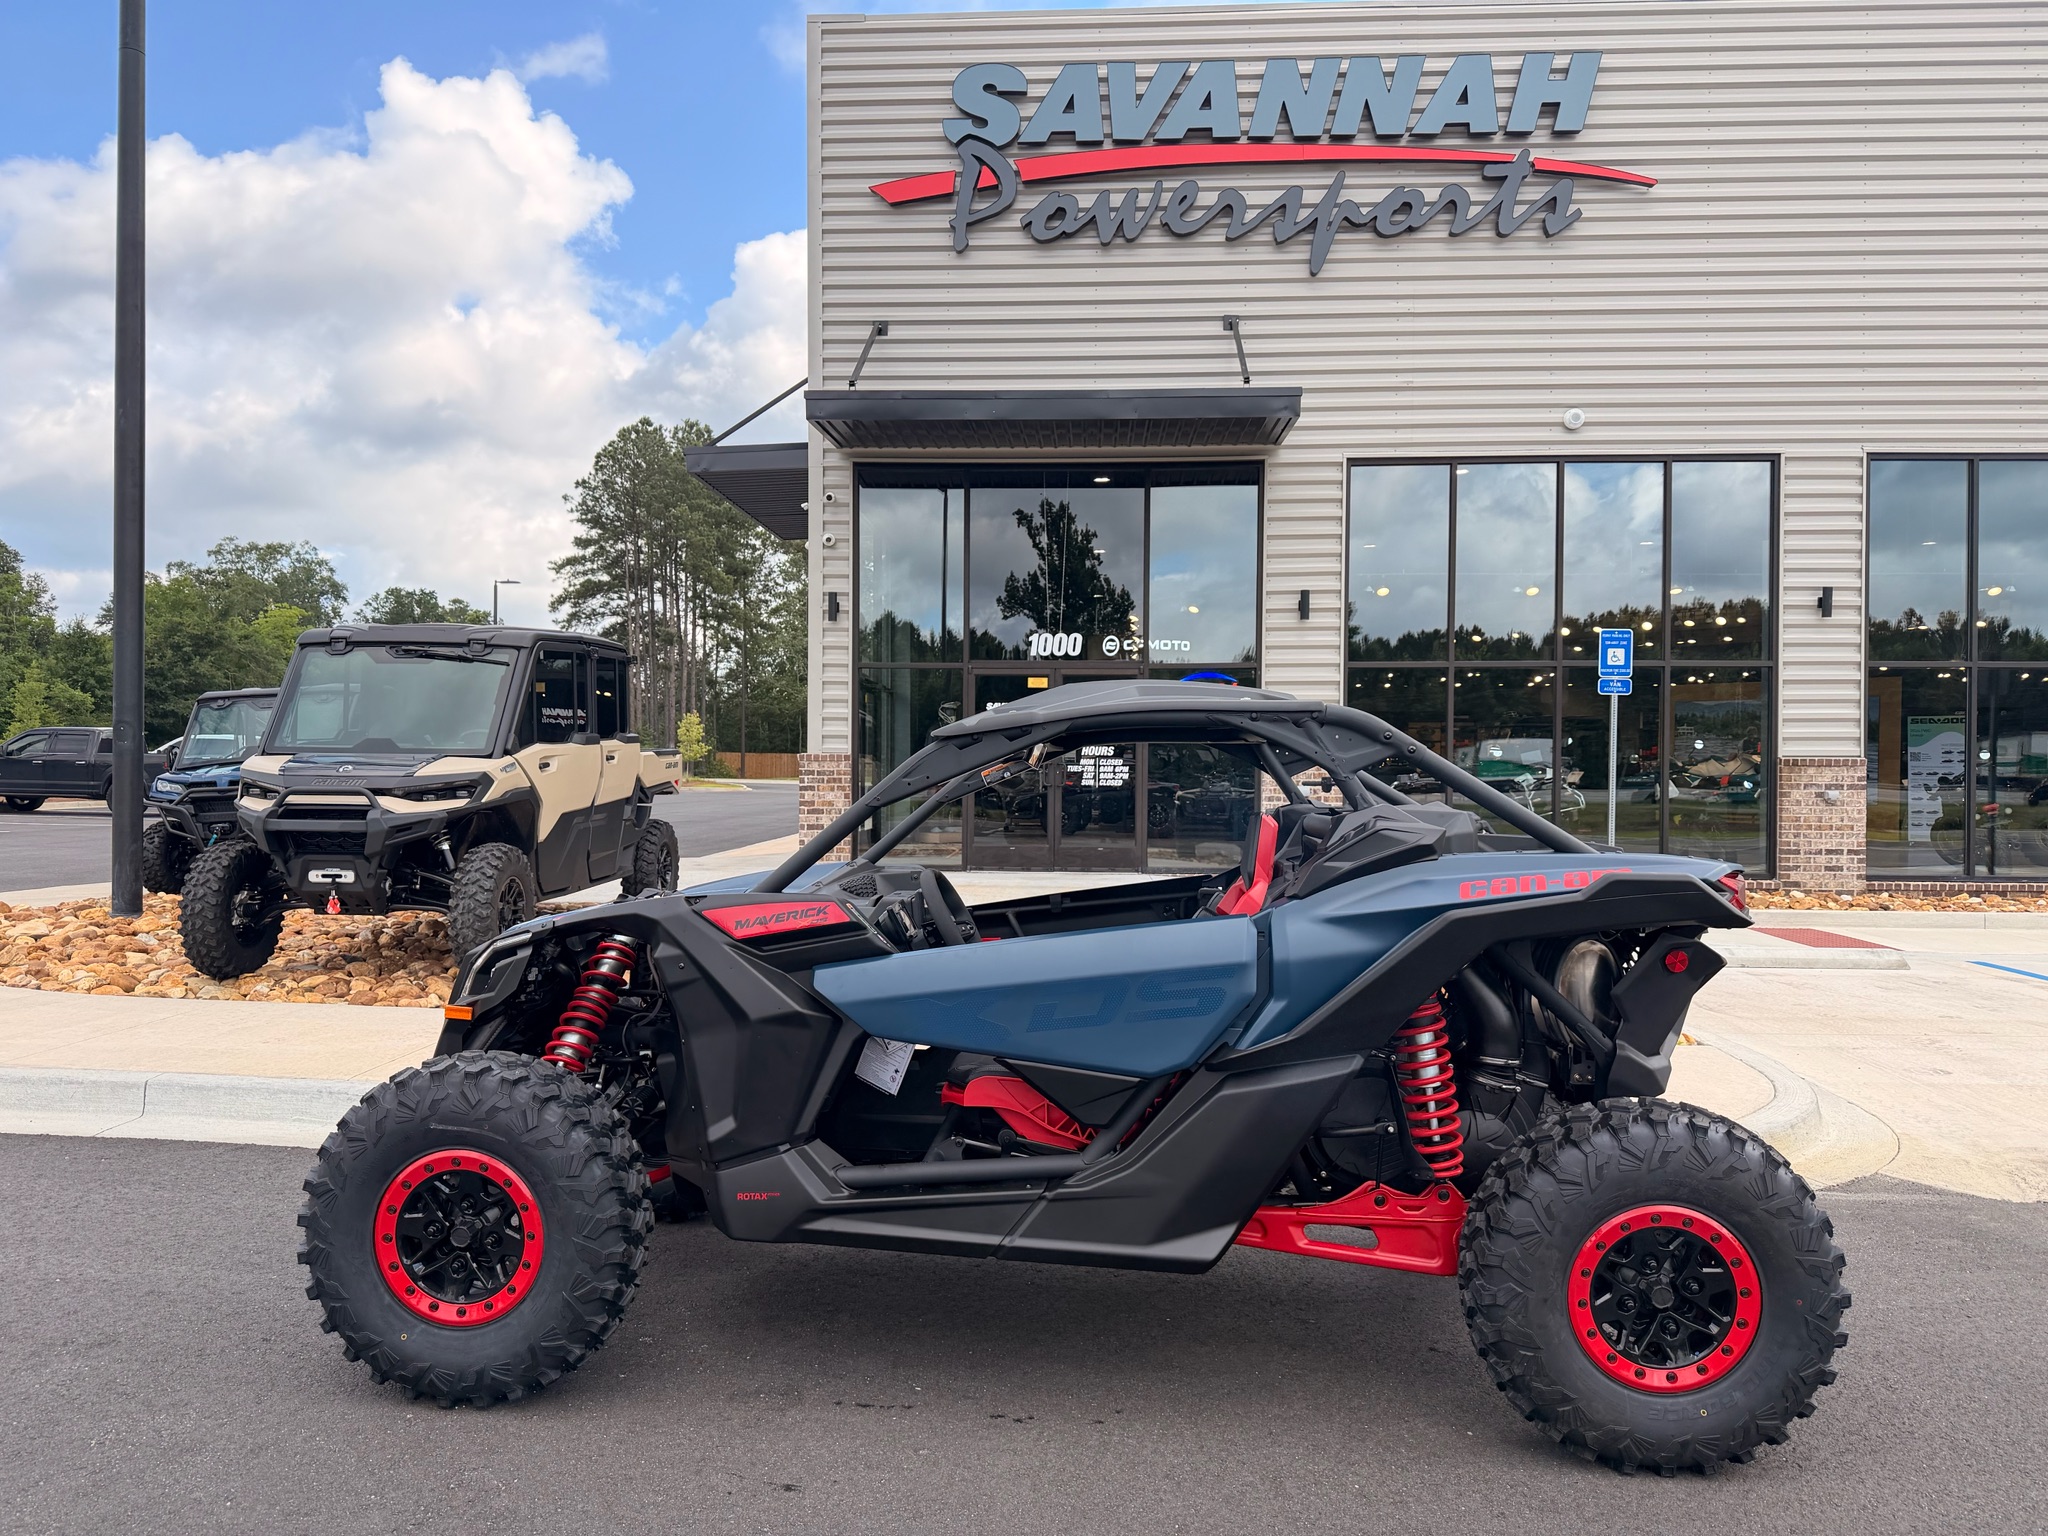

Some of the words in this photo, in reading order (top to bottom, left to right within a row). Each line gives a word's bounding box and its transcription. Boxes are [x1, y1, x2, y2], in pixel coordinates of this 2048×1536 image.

[942, 51, 1603, 146] SAVANNAH
[953, 139, 1582, 276] Powersports
[1029, 632, 1083, 657] 1000
[1081, 746, 1115, 756] HOURS
[734, 904, 831, 931] MAVERICK
[737, 1192, 768, 1201] ROTAX
